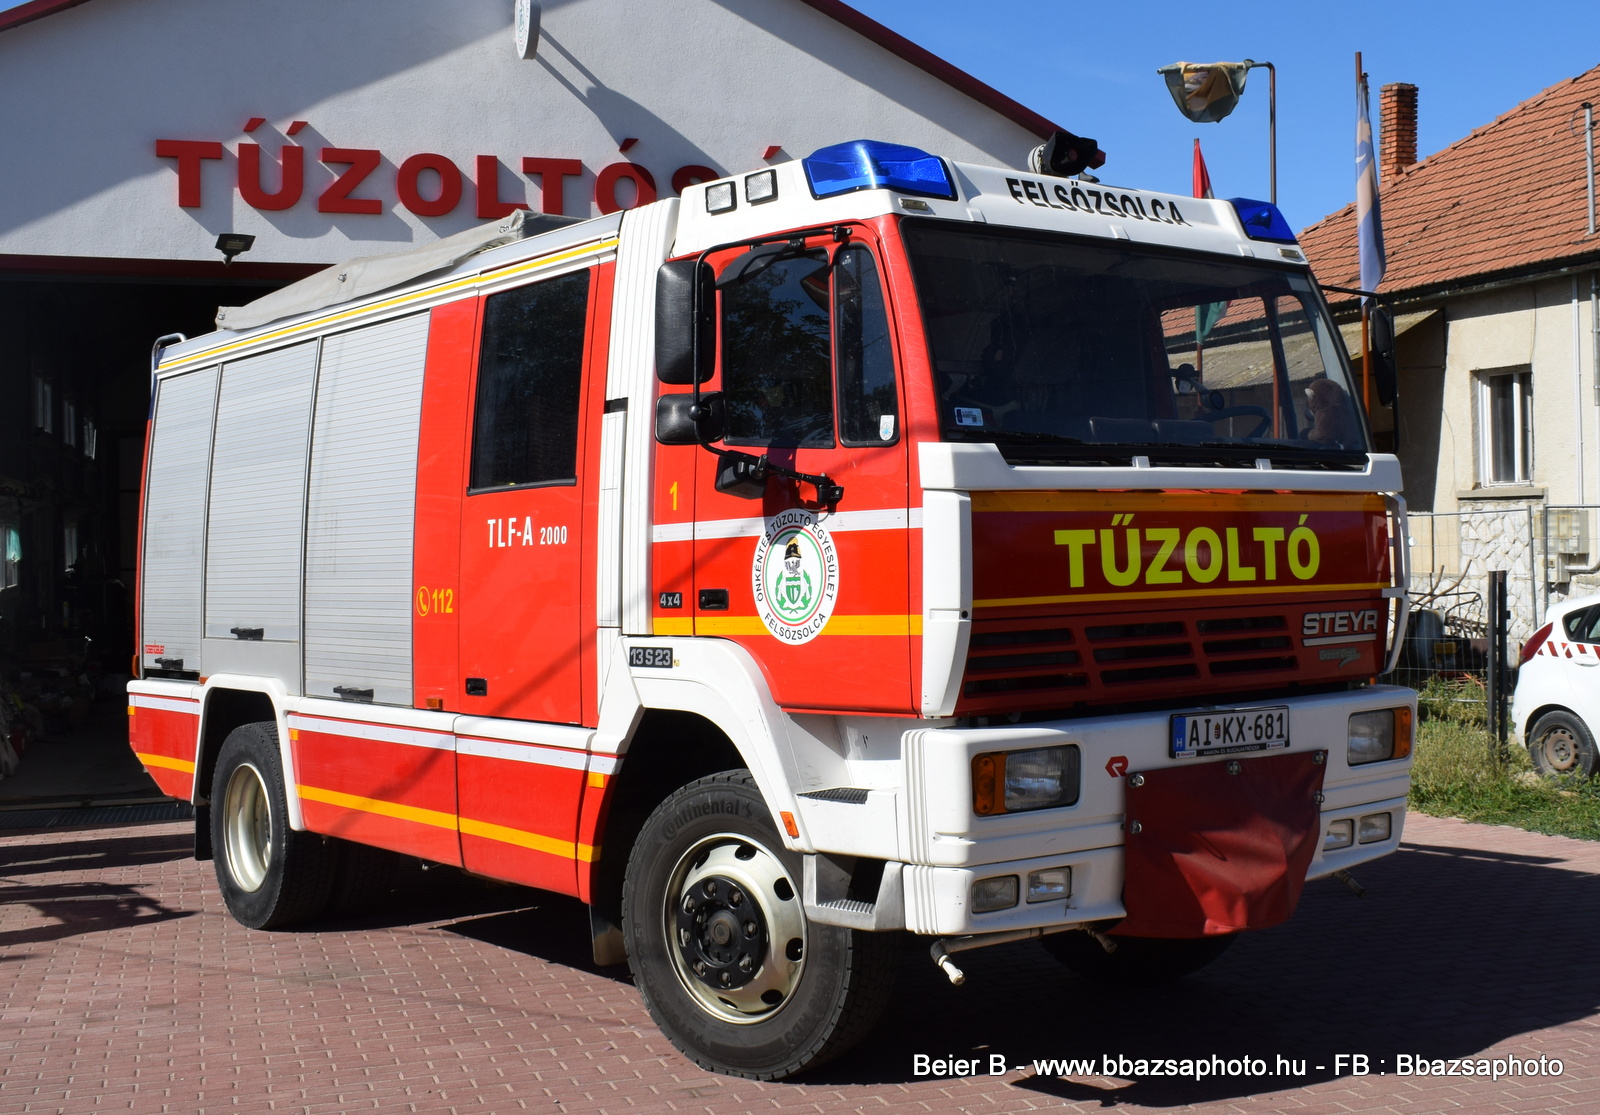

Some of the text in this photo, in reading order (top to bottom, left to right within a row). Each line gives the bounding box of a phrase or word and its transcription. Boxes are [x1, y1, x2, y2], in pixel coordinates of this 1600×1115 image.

[156, 117, 783, 219] TŰZOLTÓ
[669, 481, 679, 511] 1
[487, 516, 568, 548] TLF-A 2000
[771, 512, 811, 532] TŰZOLTÓ
[811, 522, 837, 602] EGYESÜLET
[1054, 513, 1321, 588] TŰZOLTÓ
[432, 588, 454, 614] 112
[659, 593, 681, 607] 4x4
[1303, 609, 1379, 636] STEYR
[1176, 737, 1183, 748] H
[1189, 718, 1212, 748] AI
[661, 799, 740, 841] Continental
